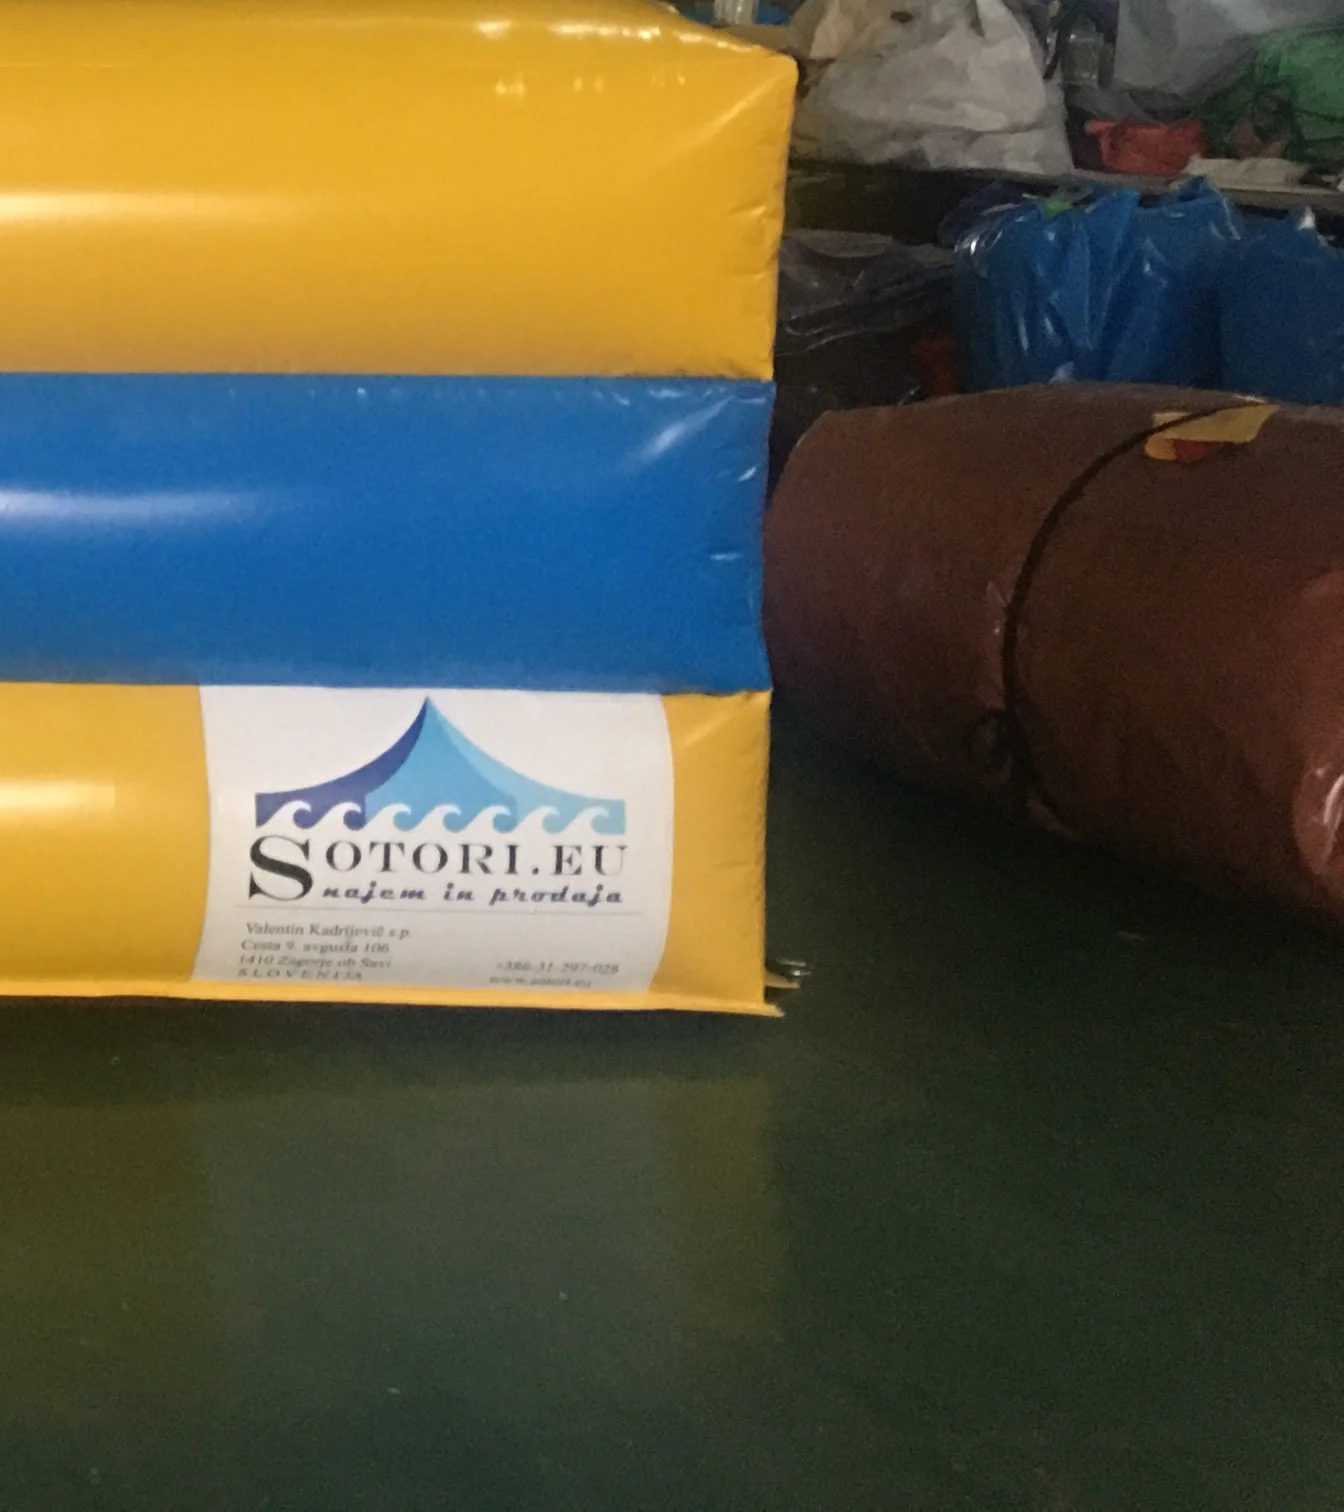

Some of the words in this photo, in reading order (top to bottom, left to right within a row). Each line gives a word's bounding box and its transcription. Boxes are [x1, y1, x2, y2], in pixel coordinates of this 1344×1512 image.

[249, 835, 628, 901] SOTORI.EU
[323, 881, 425, 904] najem
[443, 882, 474, 901] in
[489, 884, 623, 907] prodaja
[246, 922, 304, 936] Valentin
[241, 940, 281, 951] Cesta
